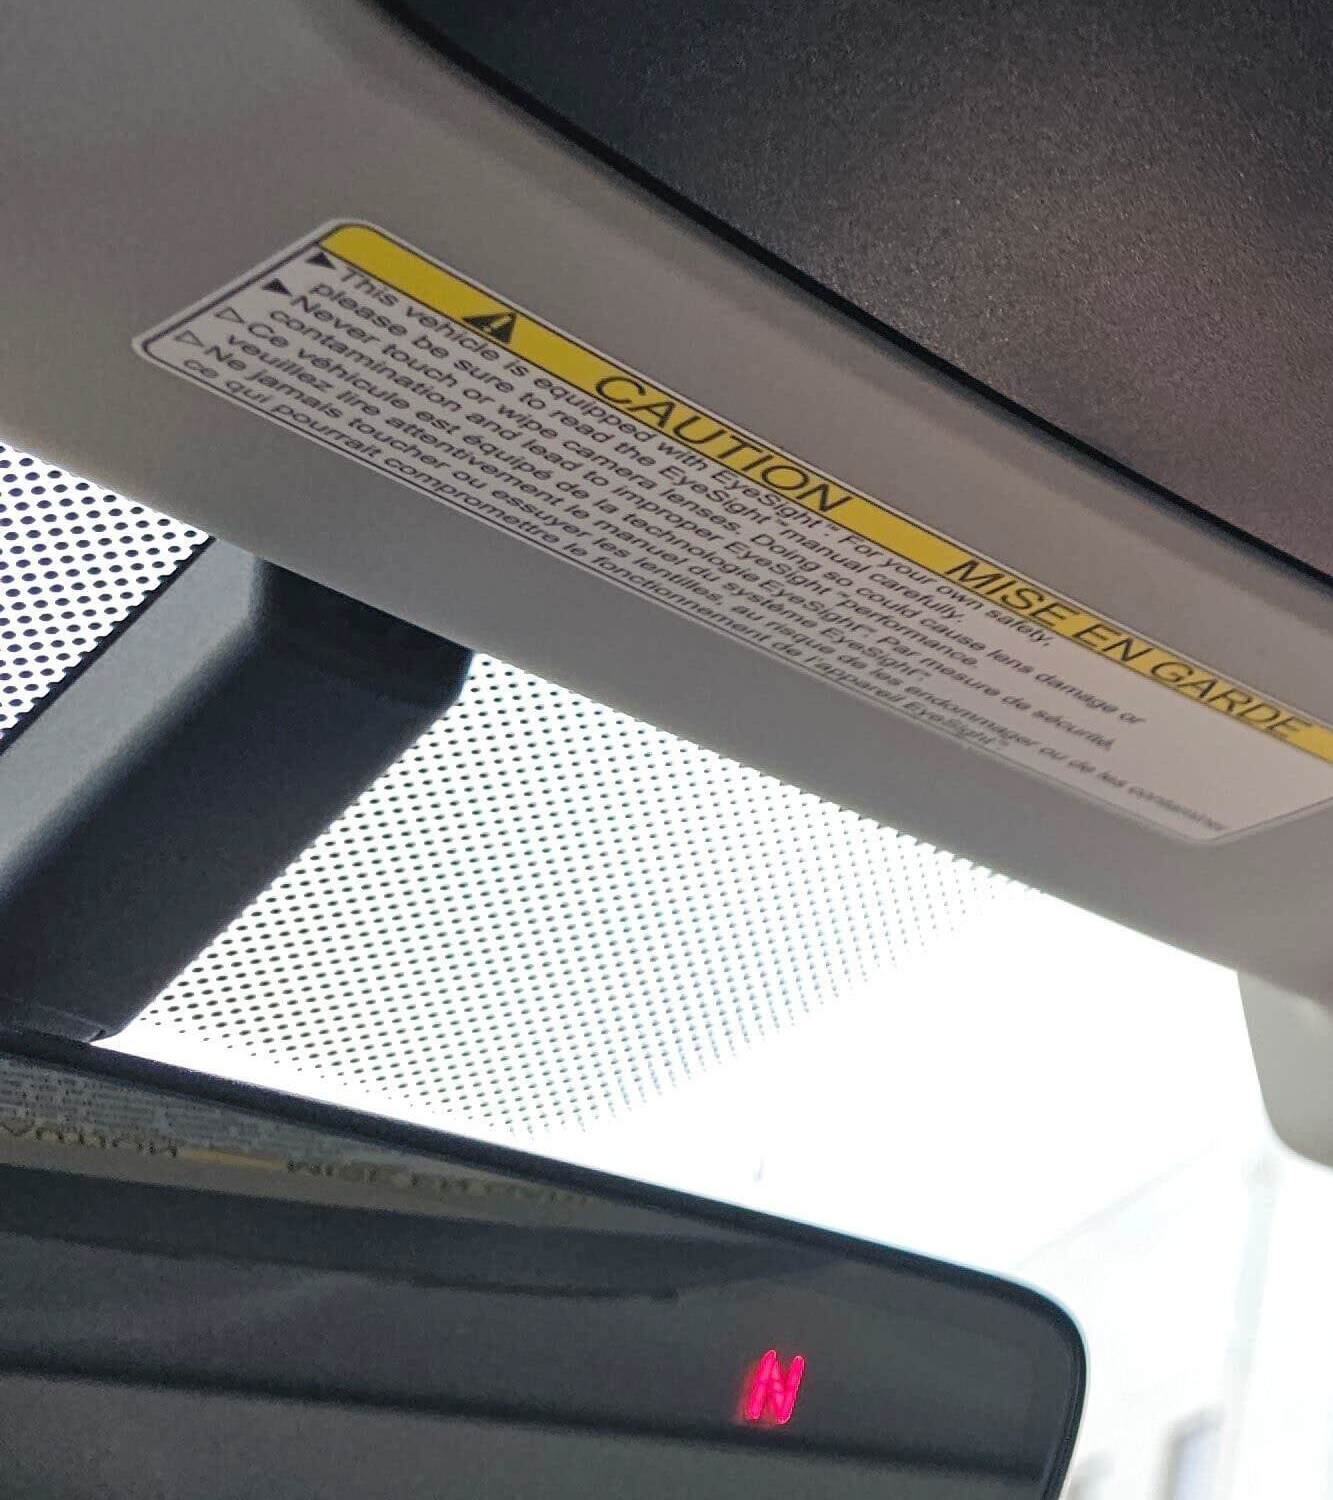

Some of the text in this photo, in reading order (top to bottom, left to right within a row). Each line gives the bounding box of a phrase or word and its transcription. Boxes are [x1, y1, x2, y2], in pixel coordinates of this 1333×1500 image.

[183, 359, 219, 378] ce
[225, 380, 276, 403] qui
[269, 404, 385, 457] pourrait
[384, 457, 560, 543] compromettre
[561, 541, 589, 556] le
[590, 555, 774, 641] fonctionnement
[772, 640, 803, 656] de
[203, 345, 246, 370] Ne
[245, 368, 343, 418] jamais
[346, 417, 451, 470] toucher
[453, 471, 489, 489] ou
[491, 489, 593, 539] essuyer
[590, 536, 630, 557] les
[631, 556, 722, 606] lentilles,
[732, 605, 764, 620] au
[763, 620, 835, 653] risque
[838, 653, 867, 668] de
[867, 667, 904, 686] les
[223, 335, 333, 391] veuillez
[334, 389, 381, 415] lire
[386, 417, 568, 506] attentivement
[563, 503, 590, 518] le
[591, 520, 690, 565] manuel
[688, 564, 721, 582] du
[723, 582, 818, 627] système
[247, 323, 289, 347] Ce
[294, 349, 410, 408] véhicule
[416, 411, 464, 434] est
[463, 432, 555, 479] équipé
[556, 479, 590, 499] de
[591, 498, 618, 513] la
[620, 512, 759, 582] technologie
[875, 635, 922, 658] Par
[268, 311, 464, 411] contamination
[467, 413, 522, 439] and
[519, 438, 582, 470] lead
[581, 470, 609, 486] to
[610, 485, 723, 543] improper
[290, 295, 380, 345] Never
[381, 344, 464, 387] touch
[463, 388, 495, 406] or
[494, 405, 558, 438] wipe
[562, 440, 656, 488] camera
[657, 487, 739, 534] lenses.
[748, 533, 820, 572] Doing
[824, 572, 853, 586] so
[855, 587, 922, 617] could
[919, 618, 986, 650] cause
[304, 285, 407, 335] please
[410, 335, 448, 357] be
[453, 360, 514, 392] sure
[517, 392, 545, 409] to
[546, 410, 613, 441] read
[612, 442, 655, 465] the
[778, 529, 872, 572] manual
[869, 573, 962, 622] carefully.
[335, 269, 398, 305] This
[402, 307, 499, 360] vehicle
[502, 360, 529, 376] is
[533, 378, 656, 441] equipped
[656, 443, 713, 470] with
[837, 535, 883, 559] For
[881, 558, 936, 585] your
[936, 585, 985, 609] own
[596, 376, 856, 509] CAUTION
[941, 559, 1313, 738] MISE EN GARDE
[748, 1349, 805, 1425] N
